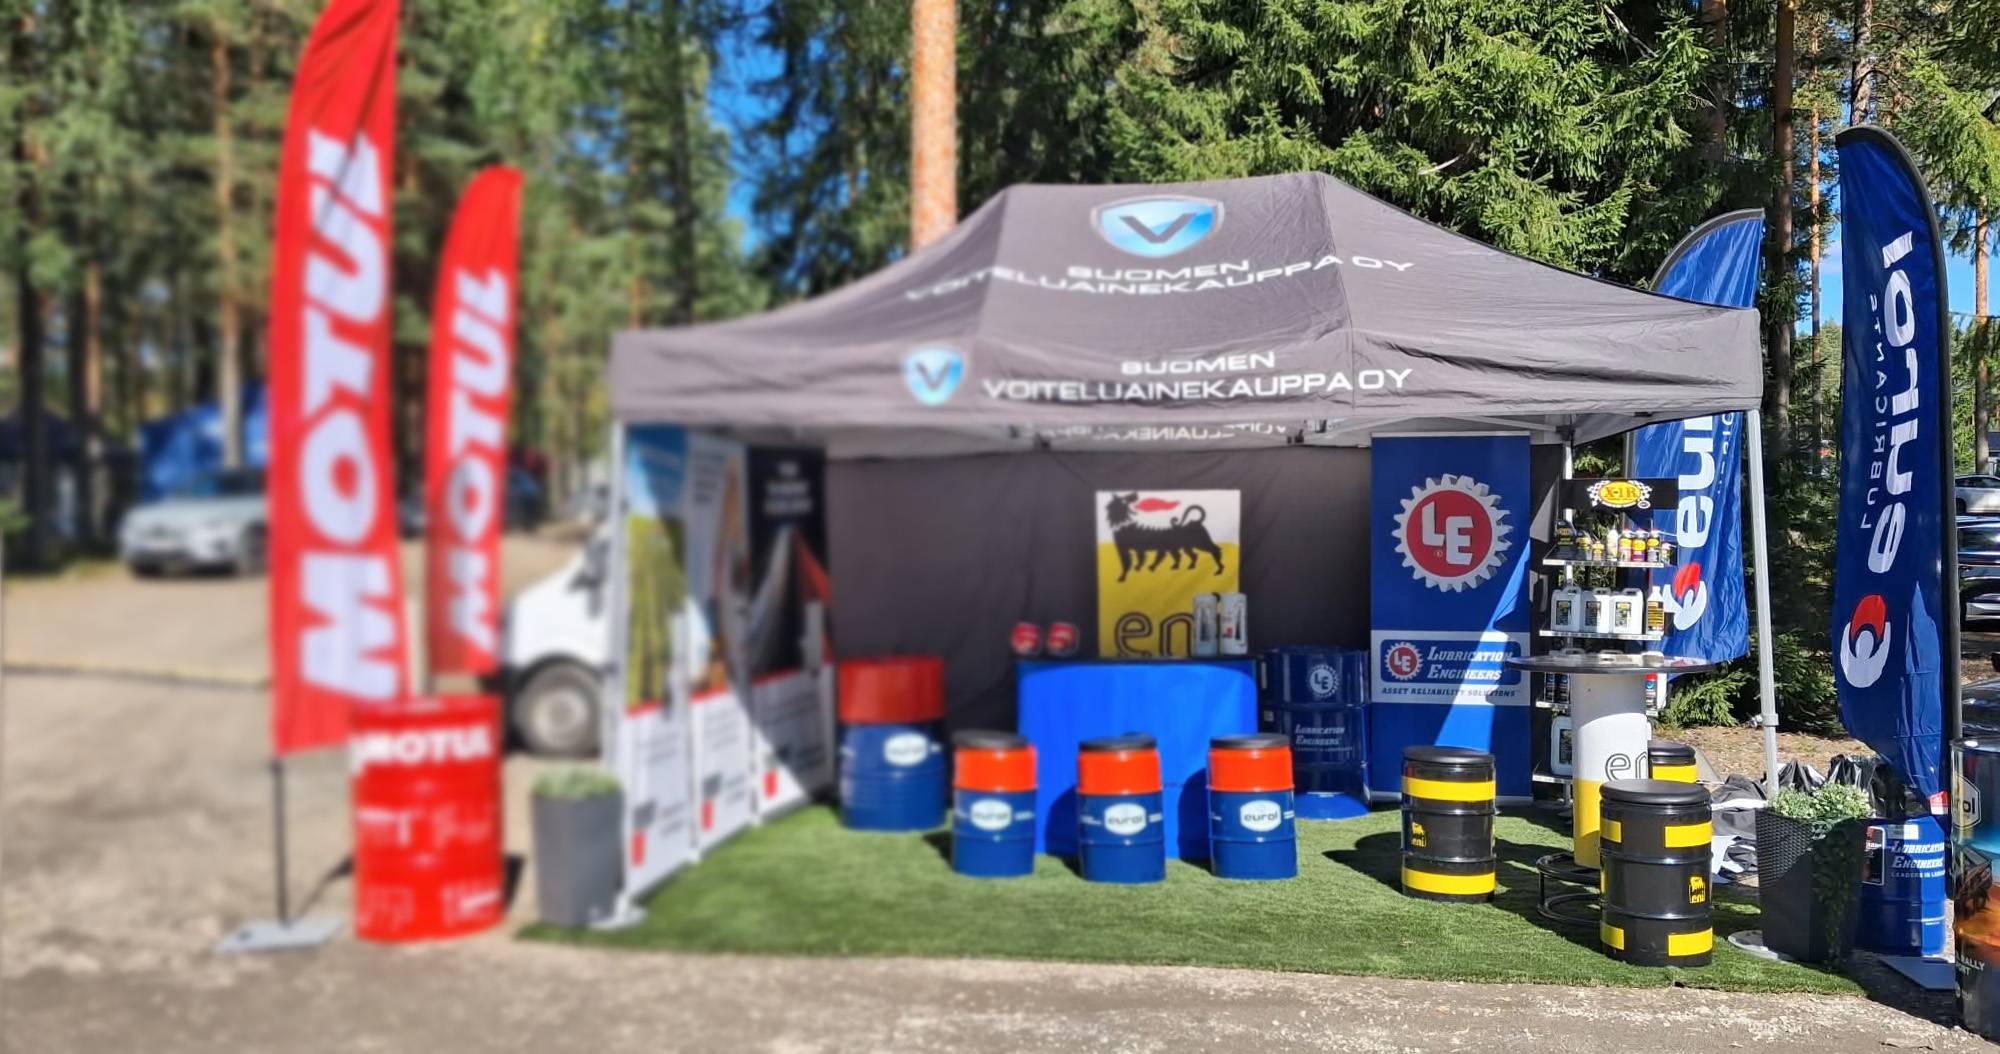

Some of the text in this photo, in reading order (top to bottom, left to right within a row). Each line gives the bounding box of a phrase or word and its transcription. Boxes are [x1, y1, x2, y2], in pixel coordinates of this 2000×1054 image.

[906, 255, 1414, 295] VOITELUAINEKAUPPA OY
[1066, 260, 1249, 281] SUOMEN
[1121, 351, 1275, 376] SUOMEN
[982, 369, 1413, 400] VOITELUAINEKAUPPA OY
[301, 128, 398, 699] MOTUL
[447, 267, 510, 653] MOTUL
[1421, 500, 1473, 566] LE
[1393, 651, 1411, 672] LE
[1427, 646, 1513, 661] LUBRICATION
[1313, 672, 1329, 690] LE
[1427, 664, 1502, 680] ENGINEERS
[1382, 687, 1409, 695] ASSET
[1108, 812, 1143, 825] eurol
[1243, 810, 1278, 822] eurol
